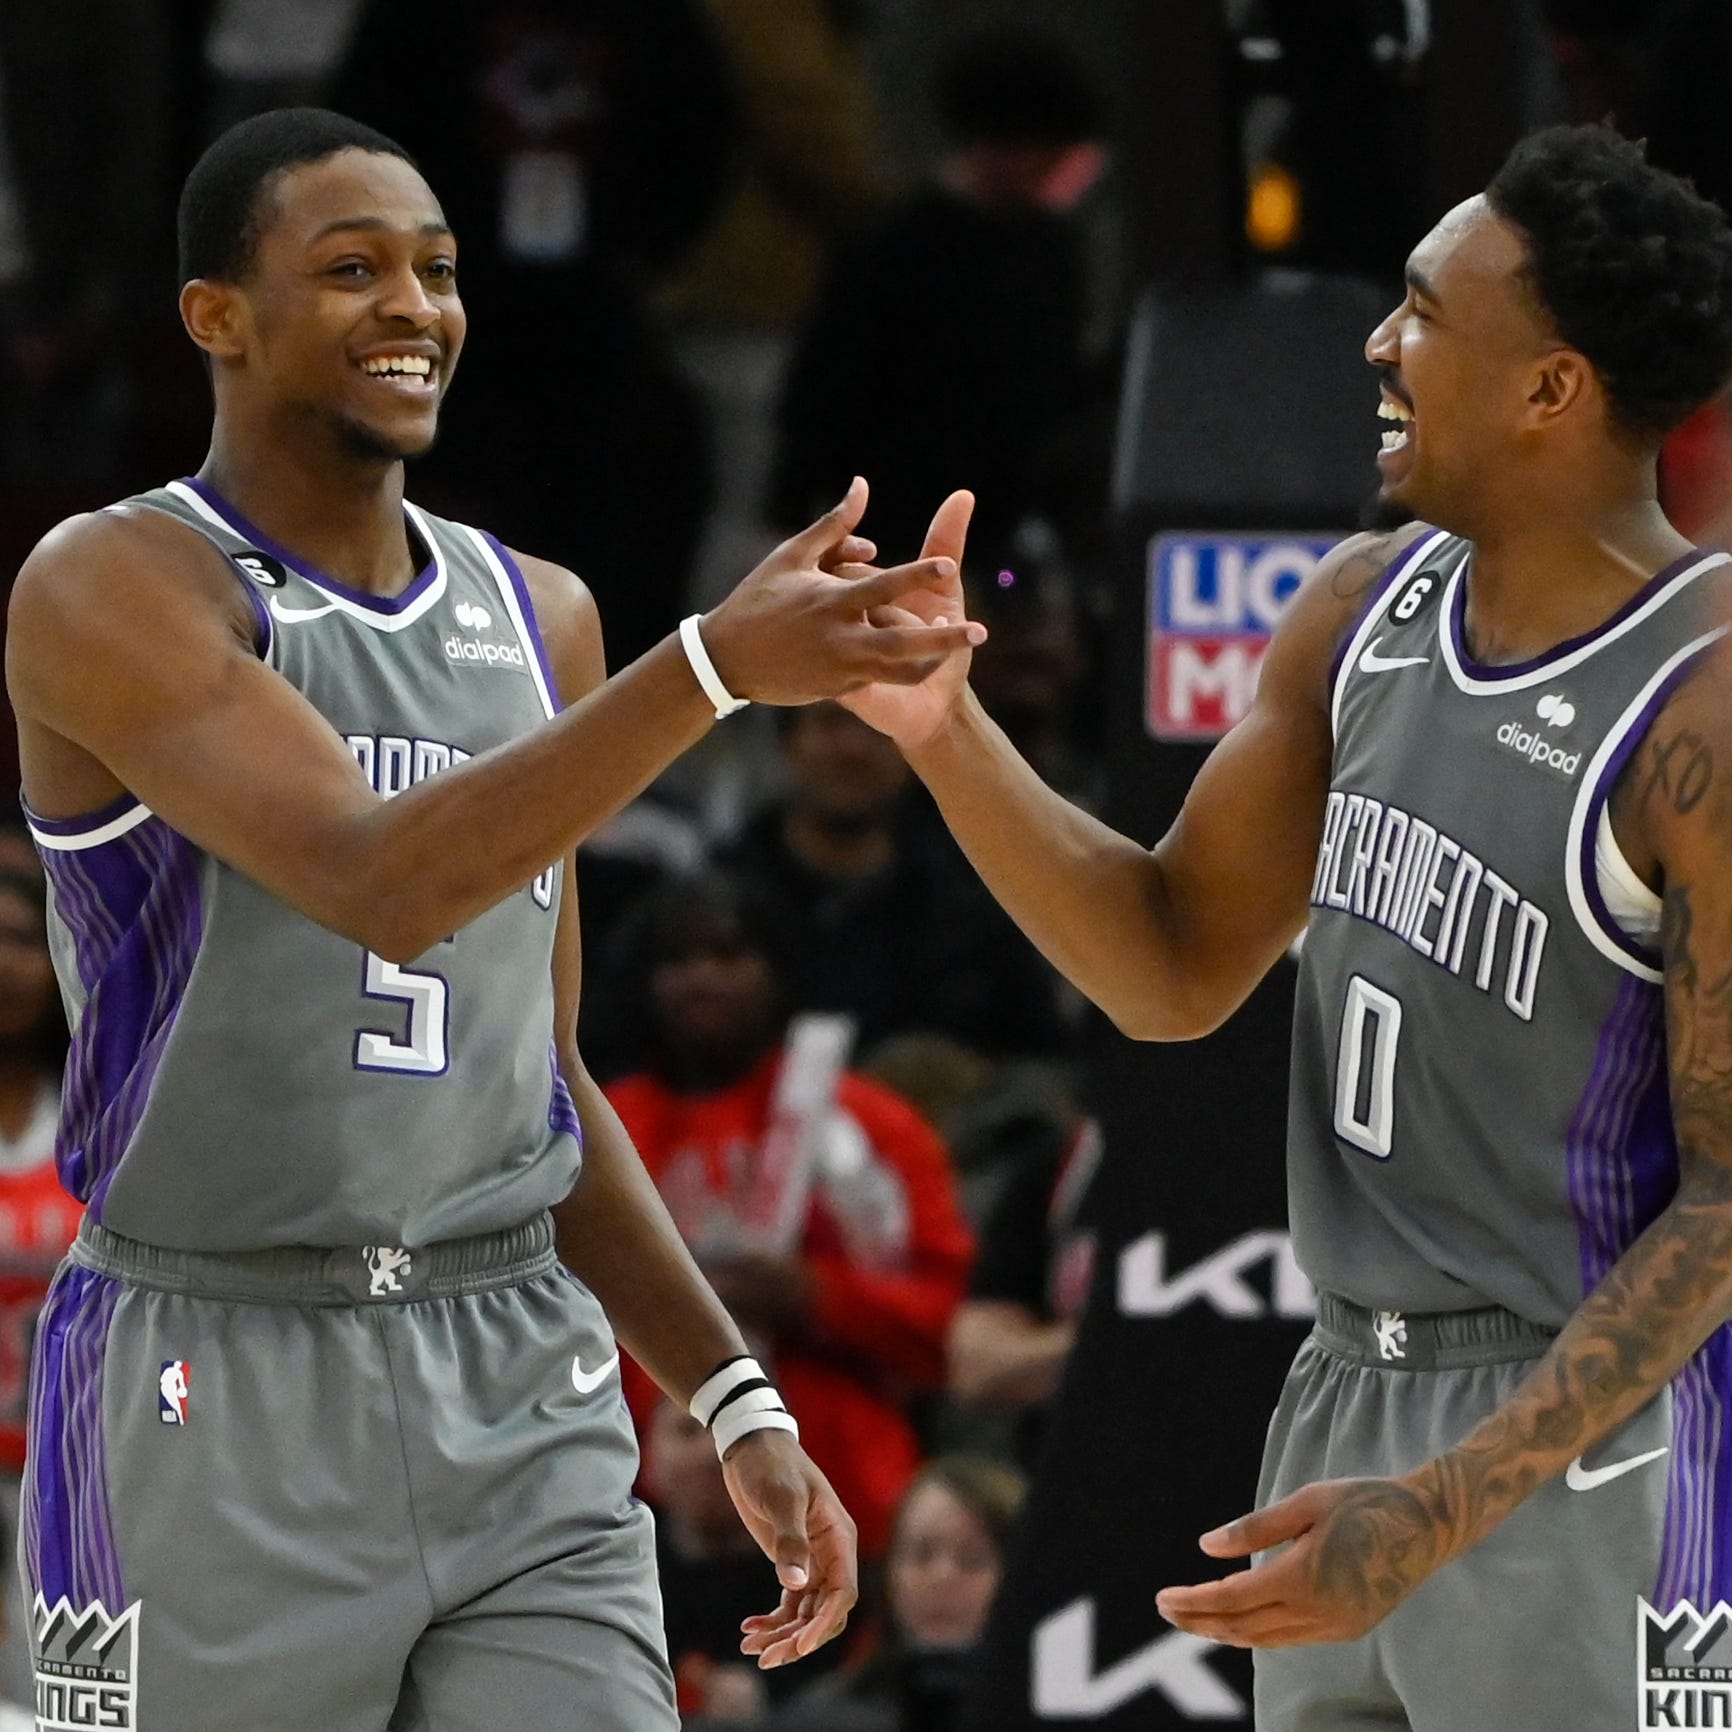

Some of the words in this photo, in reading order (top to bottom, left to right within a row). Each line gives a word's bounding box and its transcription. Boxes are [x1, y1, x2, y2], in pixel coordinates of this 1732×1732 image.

[1395, 577, 1433, 619] 6
[445, 635, 525, 666] dialpad
[1496, 721, 1582, 775] dialpad
[1311, 790, 1550, 1021] ACRAMENTO
[356, 949, 449, 1076] 5
[1334, 974, 1402, 1159] 0
[39, 1680, 130, 1728] INGS
